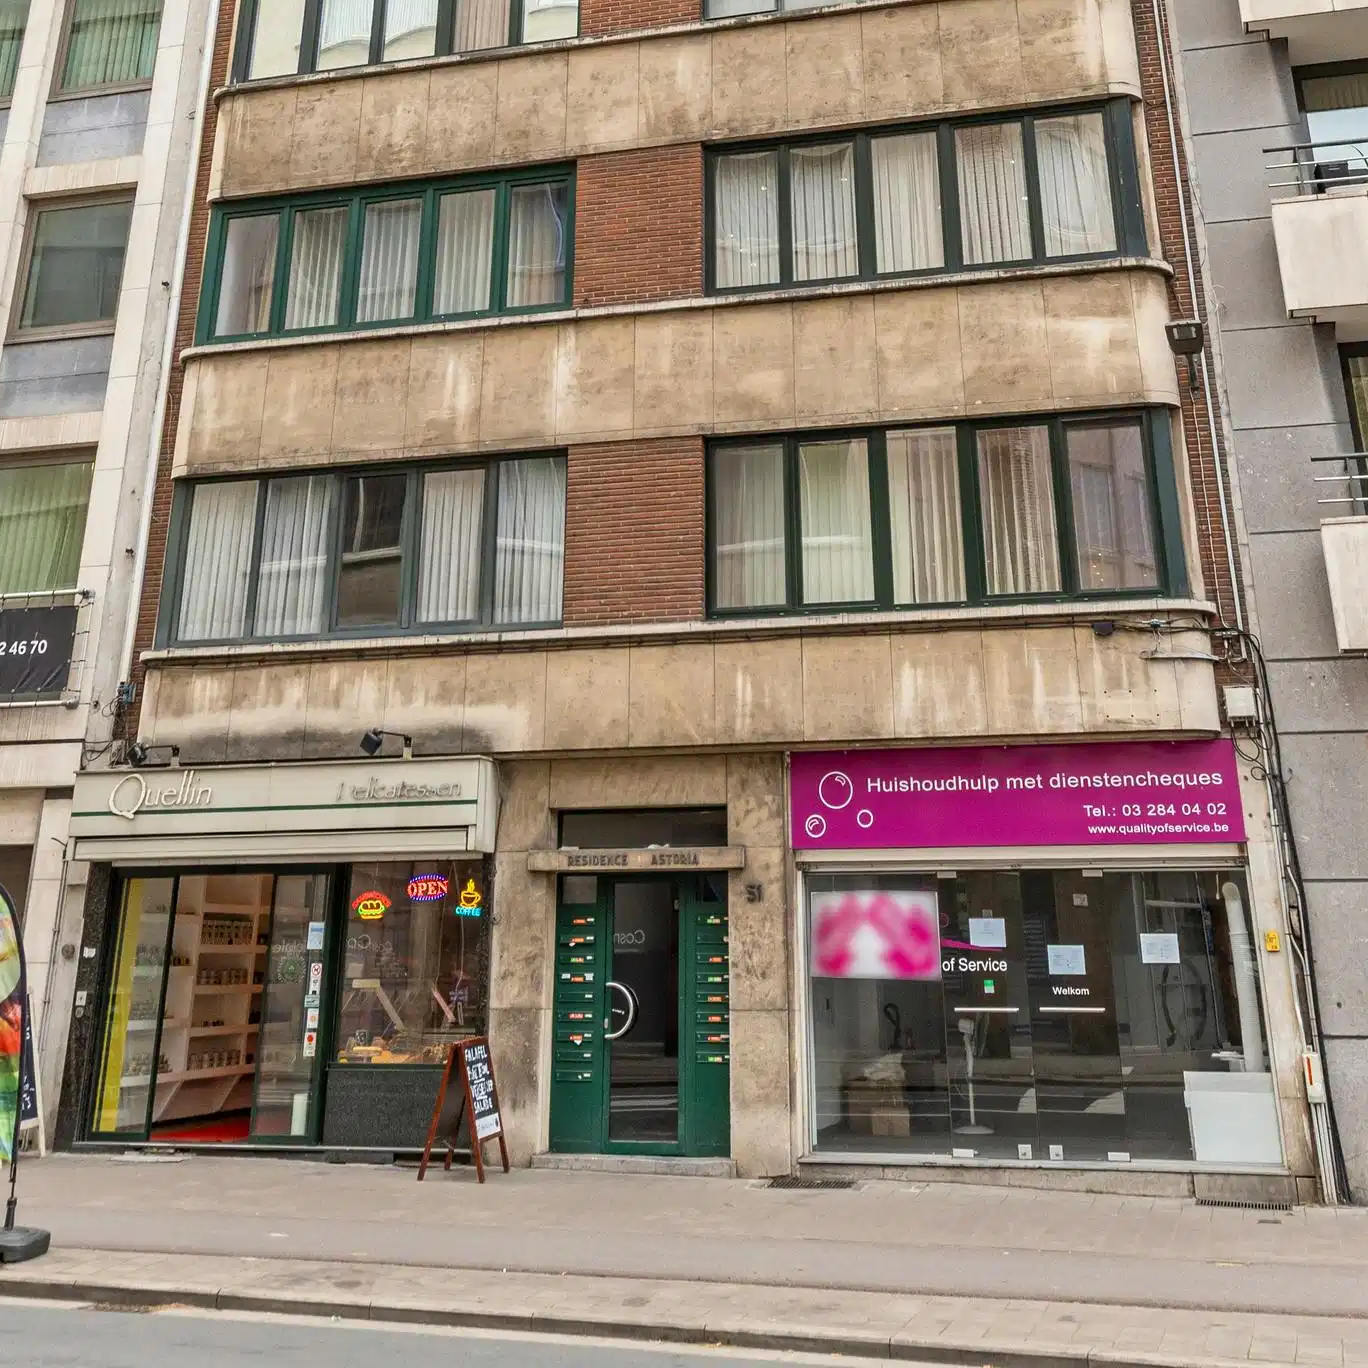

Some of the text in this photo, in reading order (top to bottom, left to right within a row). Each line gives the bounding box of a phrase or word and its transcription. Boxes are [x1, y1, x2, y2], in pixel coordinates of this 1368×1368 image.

[9, 640, 27, 655] 46
[29, 639, 48, 655] 70
[867, 769, 1224, 794] Huishoudhulp met dienstencheques
[109, 770, 212, 819] Quellin
[1083, 802, 1227, 818] Tel.: 03 284 04 02
[1088, 822, 1229, 837] www.qualityofservice.be
[567, 852, 699, 868] RESIDENCE ASTORIA
[407, 880, 448, 898] OPEN
[455, 906, 482, 917] COFFEE
[942, 958, 1008, 972] of Service
[1052, 986, 1090, 997] Welkom
